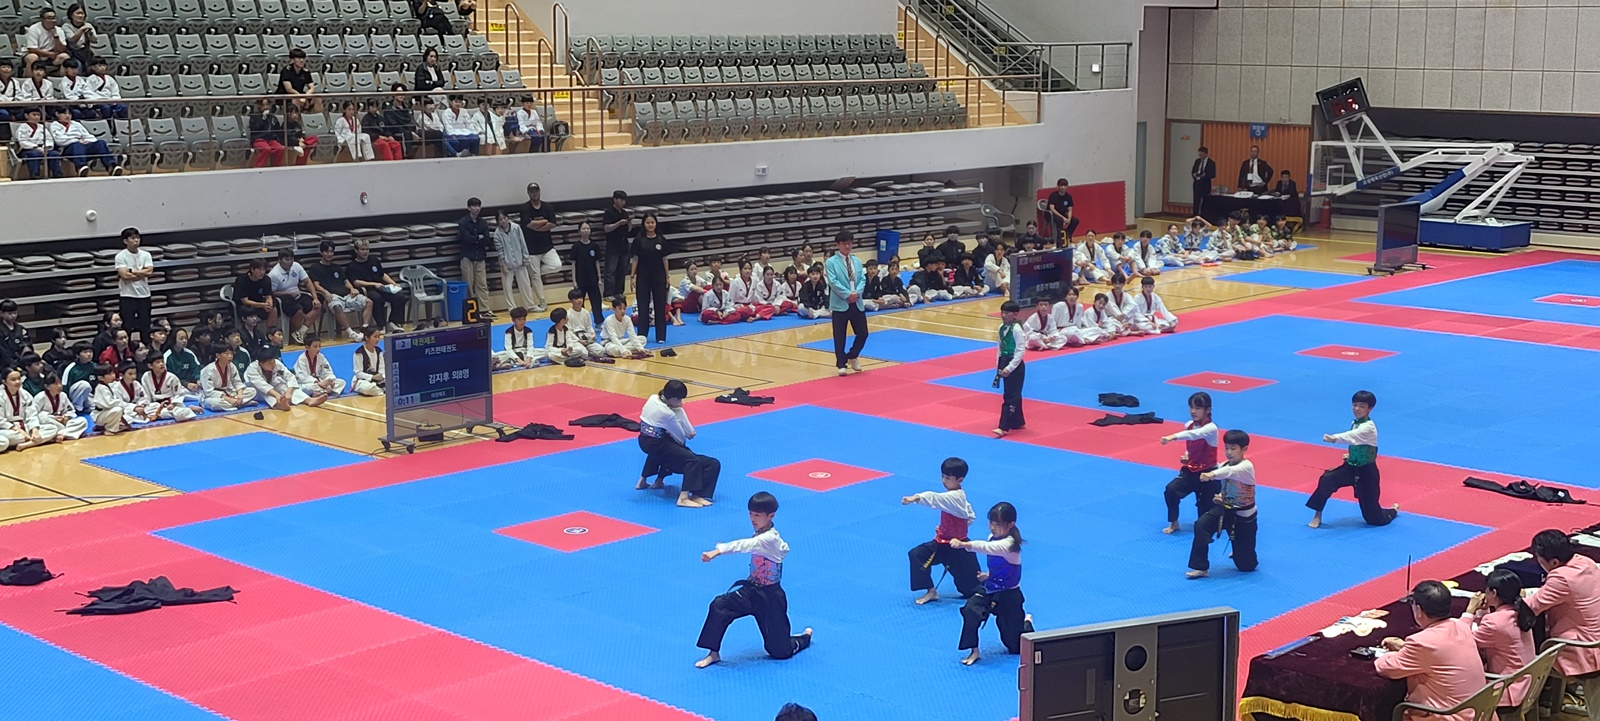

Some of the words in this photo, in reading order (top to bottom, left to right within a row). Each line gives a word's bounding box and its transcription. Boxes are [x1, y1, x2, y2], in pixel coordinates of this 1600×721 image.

[1060, 230, 1067, 247] 3
[466, 299, 478, 323] 2
[428, 371, 450, 385] 김지후
[451, 368, 470, 380] 외8명
[397, 395, 414, 406] 0:11
